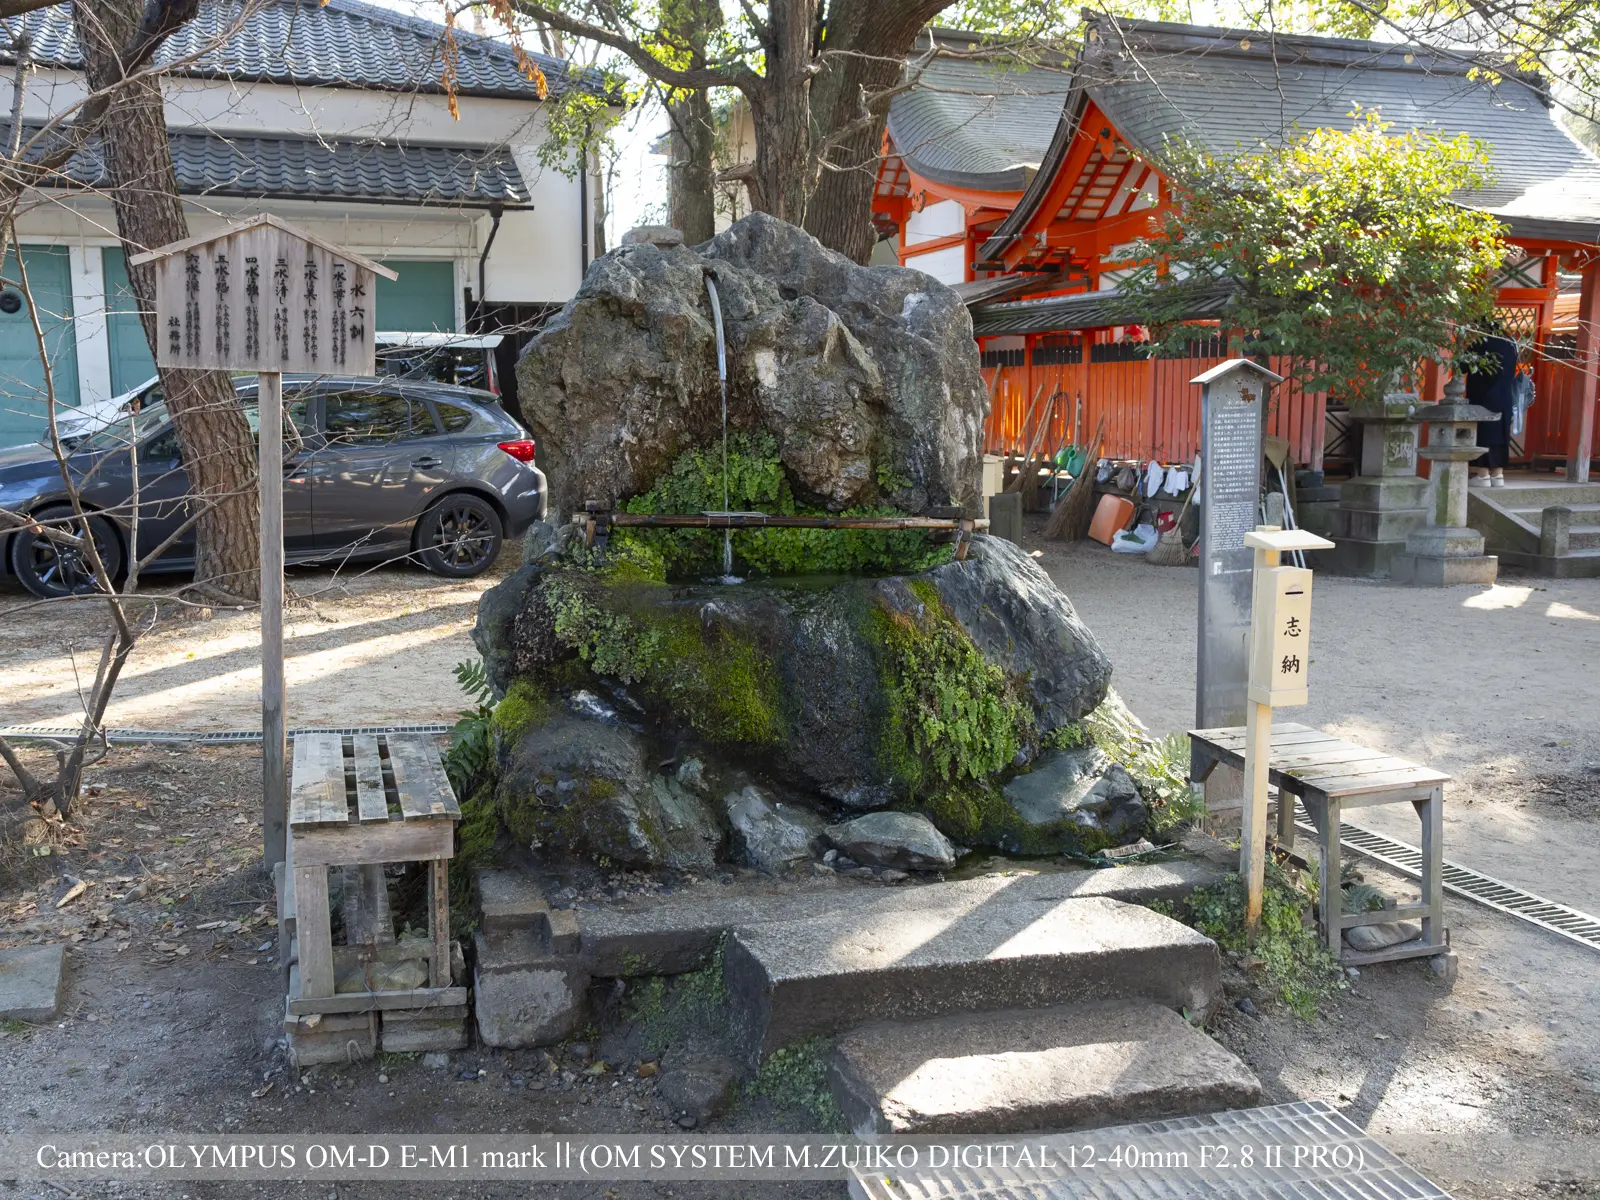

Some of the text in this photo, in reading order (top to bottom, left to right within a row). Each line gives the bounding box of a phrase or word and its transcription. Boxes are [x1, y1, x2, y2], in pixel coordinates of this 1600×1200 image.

[167, 315, 181, 357] 社務所
[350, 283, 366, 343] 水六訓
[1281, 616, 1302, 674] 志納
